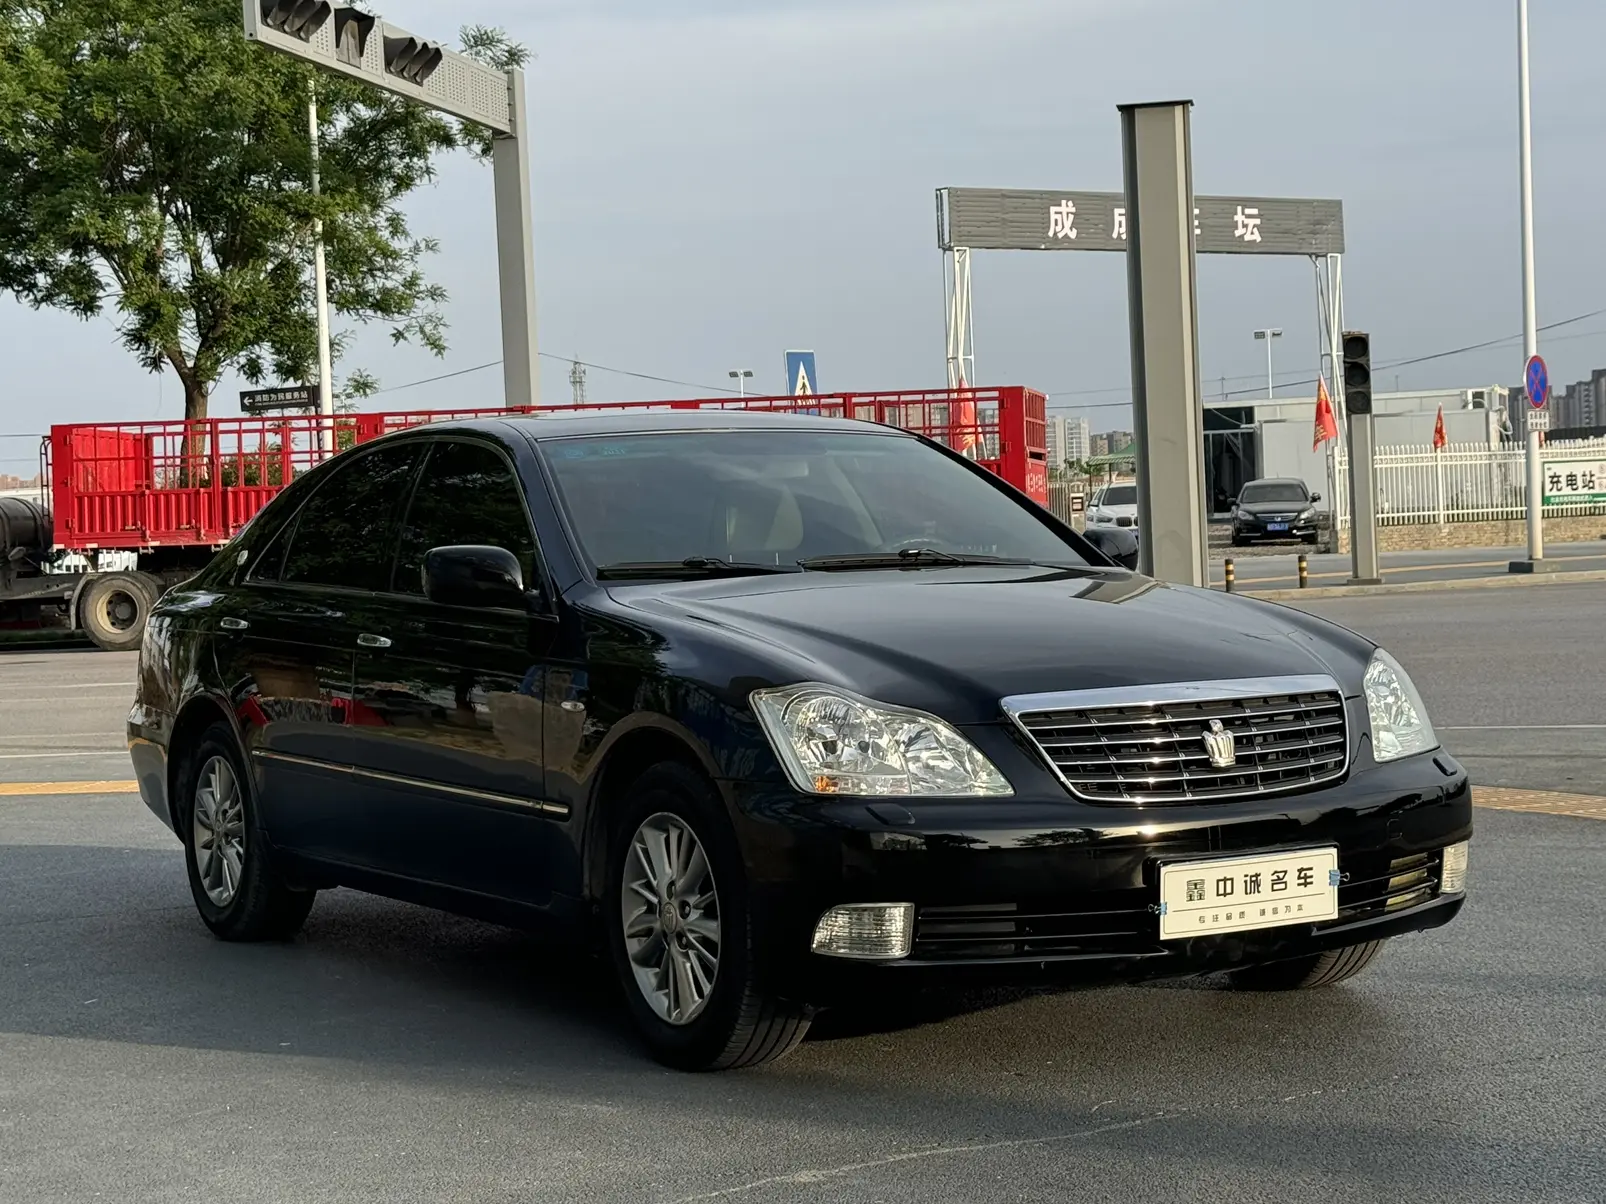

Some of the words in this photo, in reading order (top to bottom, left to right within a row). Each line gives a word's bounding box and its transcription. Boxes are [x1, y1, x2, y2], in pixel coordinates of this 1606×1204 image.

[1048, 199, 1262, 243] 成坛
[1548, 470, 1595, 492] 充电站
[1186, 867, 1314, 902] 鑫中诚名车
